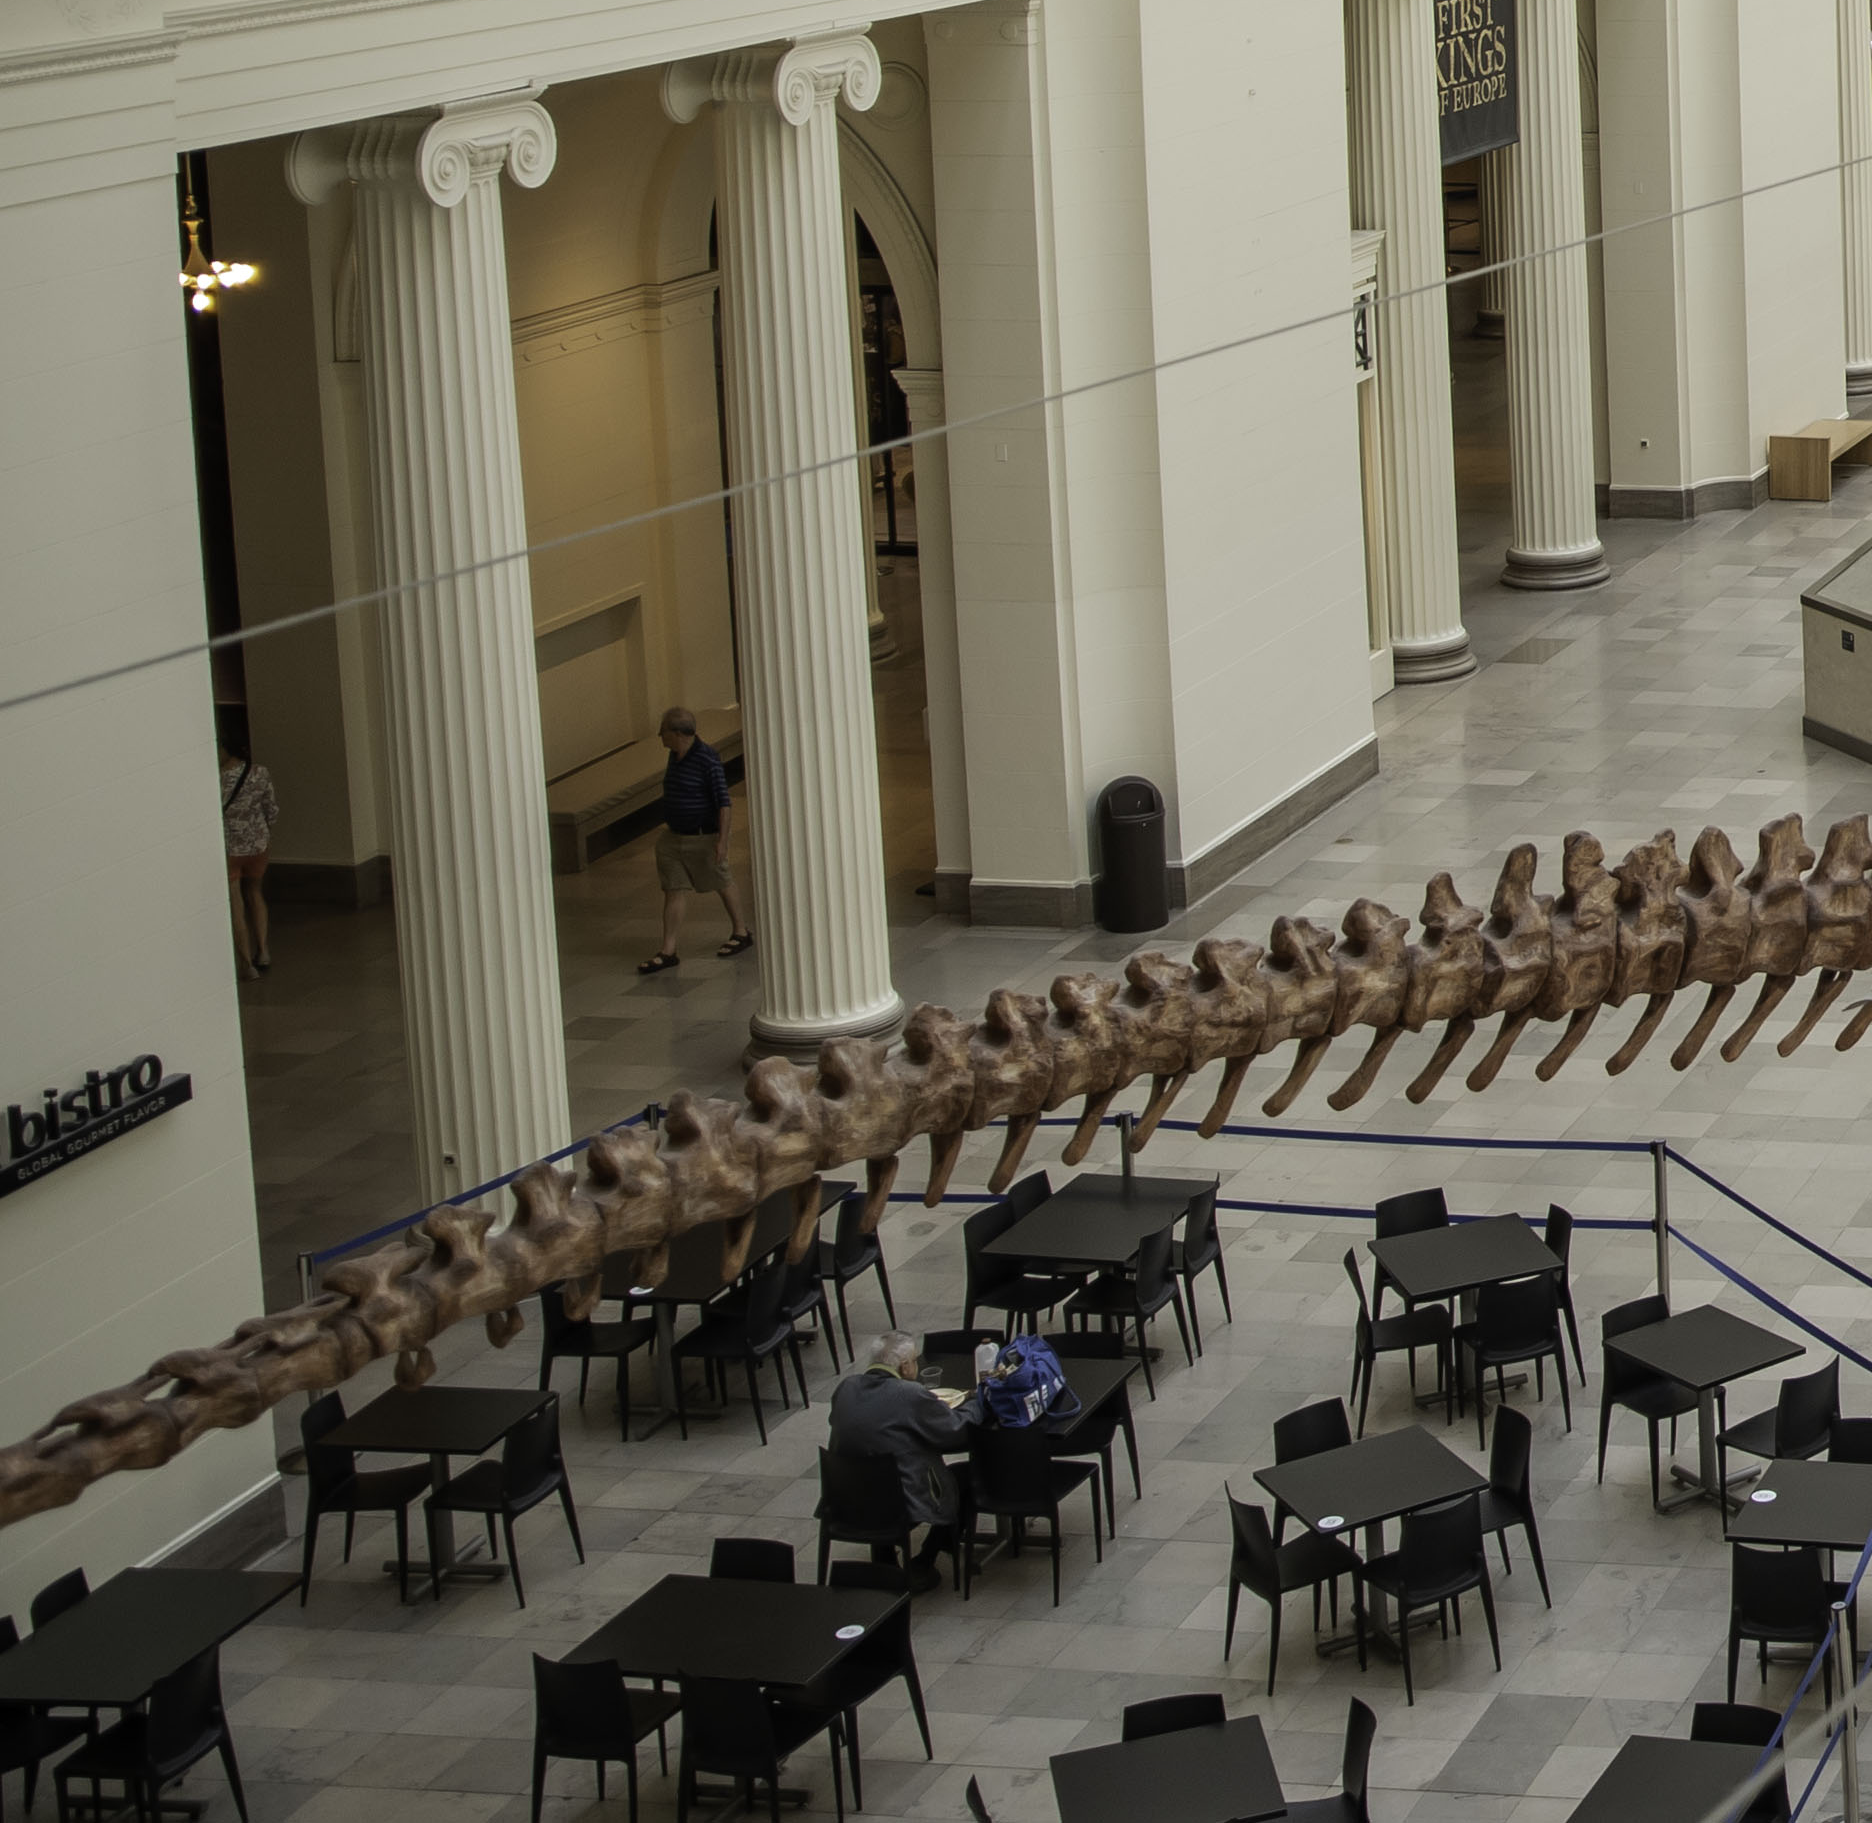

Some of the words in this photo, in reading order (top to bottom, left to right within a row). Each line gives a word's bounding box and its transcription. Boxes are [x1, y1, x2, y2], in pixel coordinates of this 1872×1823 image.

[1436, 25, 1506, 88] KINGS
[1439, 90, 1449, 116] F
[1453, 73, 1507, 112] EUROPE
[7, 1054, 163, 1159] bistro
[17, 1150, 64, 1180] GLOBAL
[66, 1119, 121, 1155] GOURMET
[123, 1096, 167, 1124] FLAVOR
